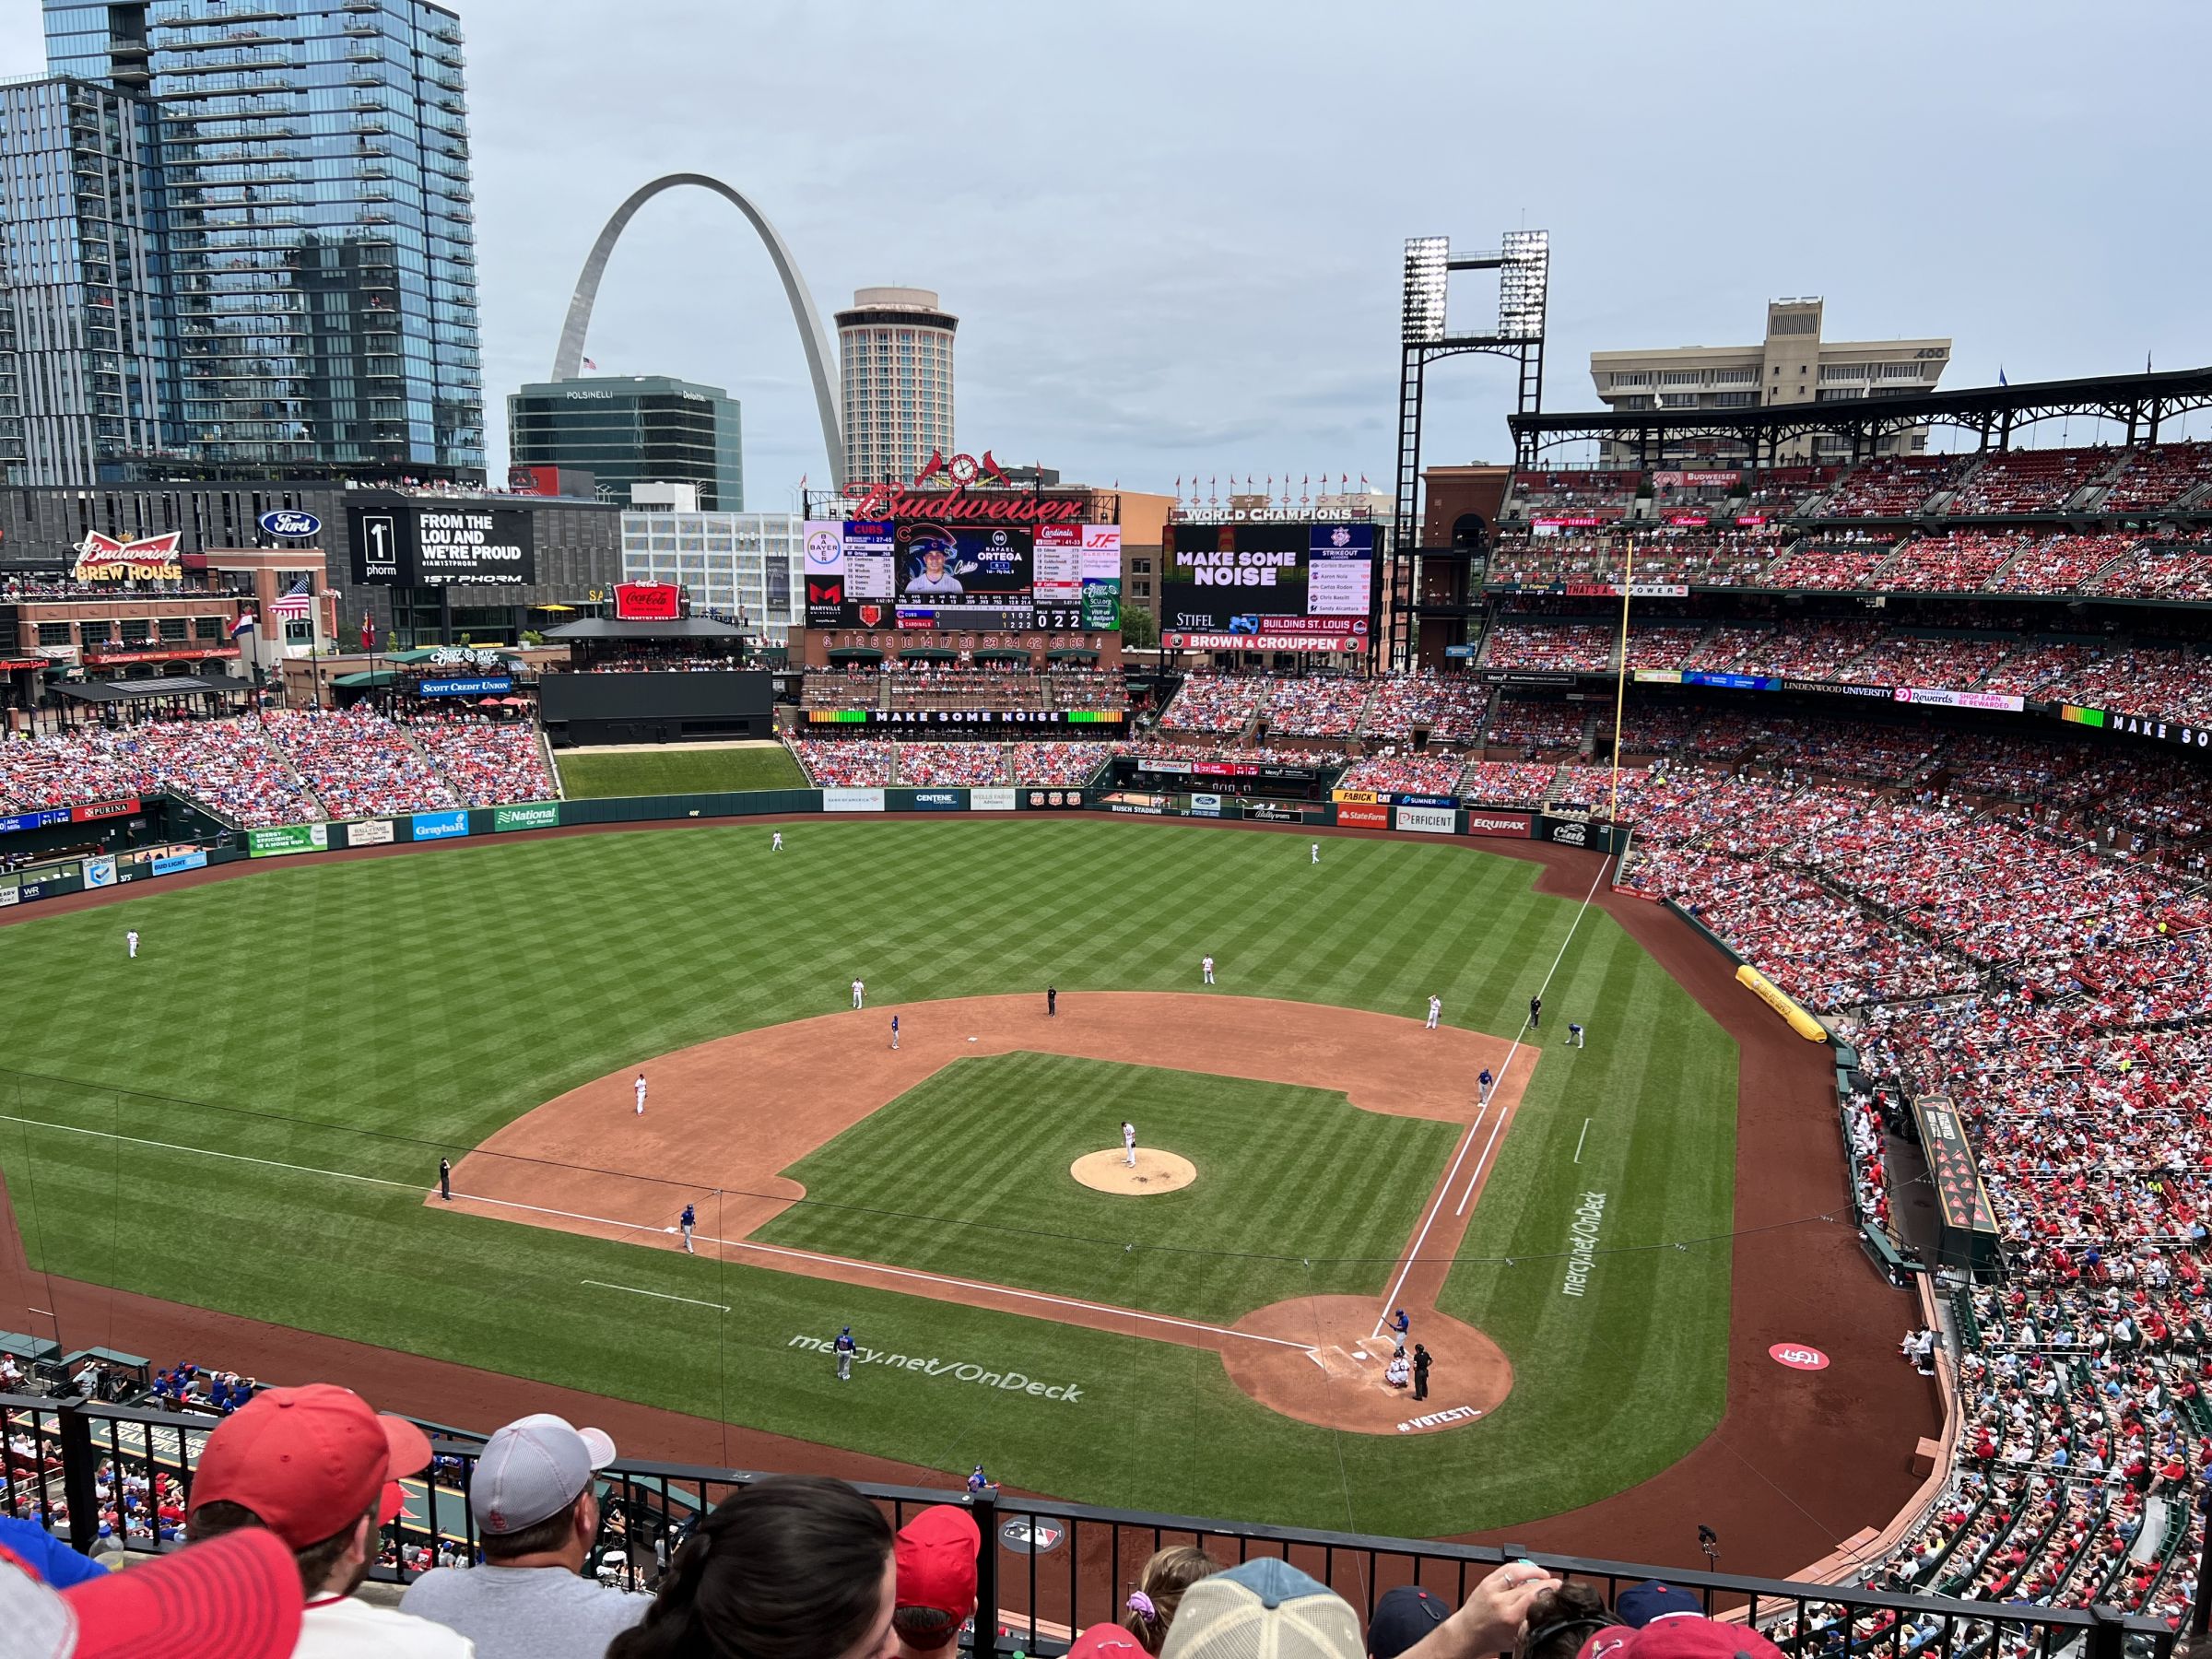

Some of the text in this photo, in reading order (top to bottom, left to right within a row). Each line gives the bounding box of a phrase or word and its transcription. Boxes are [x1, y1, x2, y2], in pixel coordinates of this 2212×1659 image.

[566, 391, 613, 400] POLSINELLI
[1688, 472, 1736, 481] BUDWEISER
[842, 481, 1082, 522] Budweiser
[1187, 507, 1353, 521] WORLD CHAMPIONS
[274, 513, 310, 533] Ford
[420, 514, 493, 529] FROM THE
[420, 529, 485, 544] LOU AND
[854, 525, 883, 535] CUBS
[1041, 525, 1073, 538] Cardinals
[72, 542, 179, 562] Budweiser
[422, 545, 522, 560] WE'RE PROUD
[977, 553, 1023, 561] ORTEGA
[1176, 552, 1296, 566] MAKE SOME
[76, 564, 183, 581] BREW HOUSE
[367, 564, 396, 577] phorm
[954, 559, 979, 575] Cubs
[1194, 567, 1277, 586] NOISE
[1568, 585, 1598, 594] THAT'S
[1600, 585, 1607, 594] A
[626, 591, 667, 605] Coca-Cola
[1038, 616, 1079, 627] 0 2 2
[1176, 612, 1215, 627] STIFEL
[1264, 619, 1349, 629] BUILDING ST. LOUIS
[844, 636, 1085, 649] 1 2 6 9 10 14 17 20 23 24 42 45 85
[1190, 636, 1338, 650] BROWN & CROUPPEN
[98, 654, 140, 664] Budweiser
[203, 649, 240, 658] Budweiser
[423, 684, 449, 692] SCOTT
[451, 683, 480, 691] CREDIT
[1784, 682, 1892, 698] LINDENWOOD UNIVERSITY
[1912, 692, 1953, 704] Rewards
[1969, 700, 2009, 709] REWARDED
[876, 712, 1059, 722] MAKE SOME NOISE
[2112, 715, 2166, 738] MAKE
[1343, 793, 1392, 803] FABICK CAT
[94, 805, 127, 815] PURINA
[1255, 811, 1275, 819] Bally
[1399, 813, 1453, 827] PERFICIENT
[1474, 818, 1524, 830] EQUIFAX
[1554, 826, 1585, 841] Club
[83, 856, 114, 866] CarShield
[168, 860, 185, 869] LIGHT
[1562, 1191, 1606, 1297] mercy.net/OnDeck
[788, 1335, 1084, 1403] mecy.net/OnDeck
[1397, 1406, 1482, 1432] #VOTESTL
